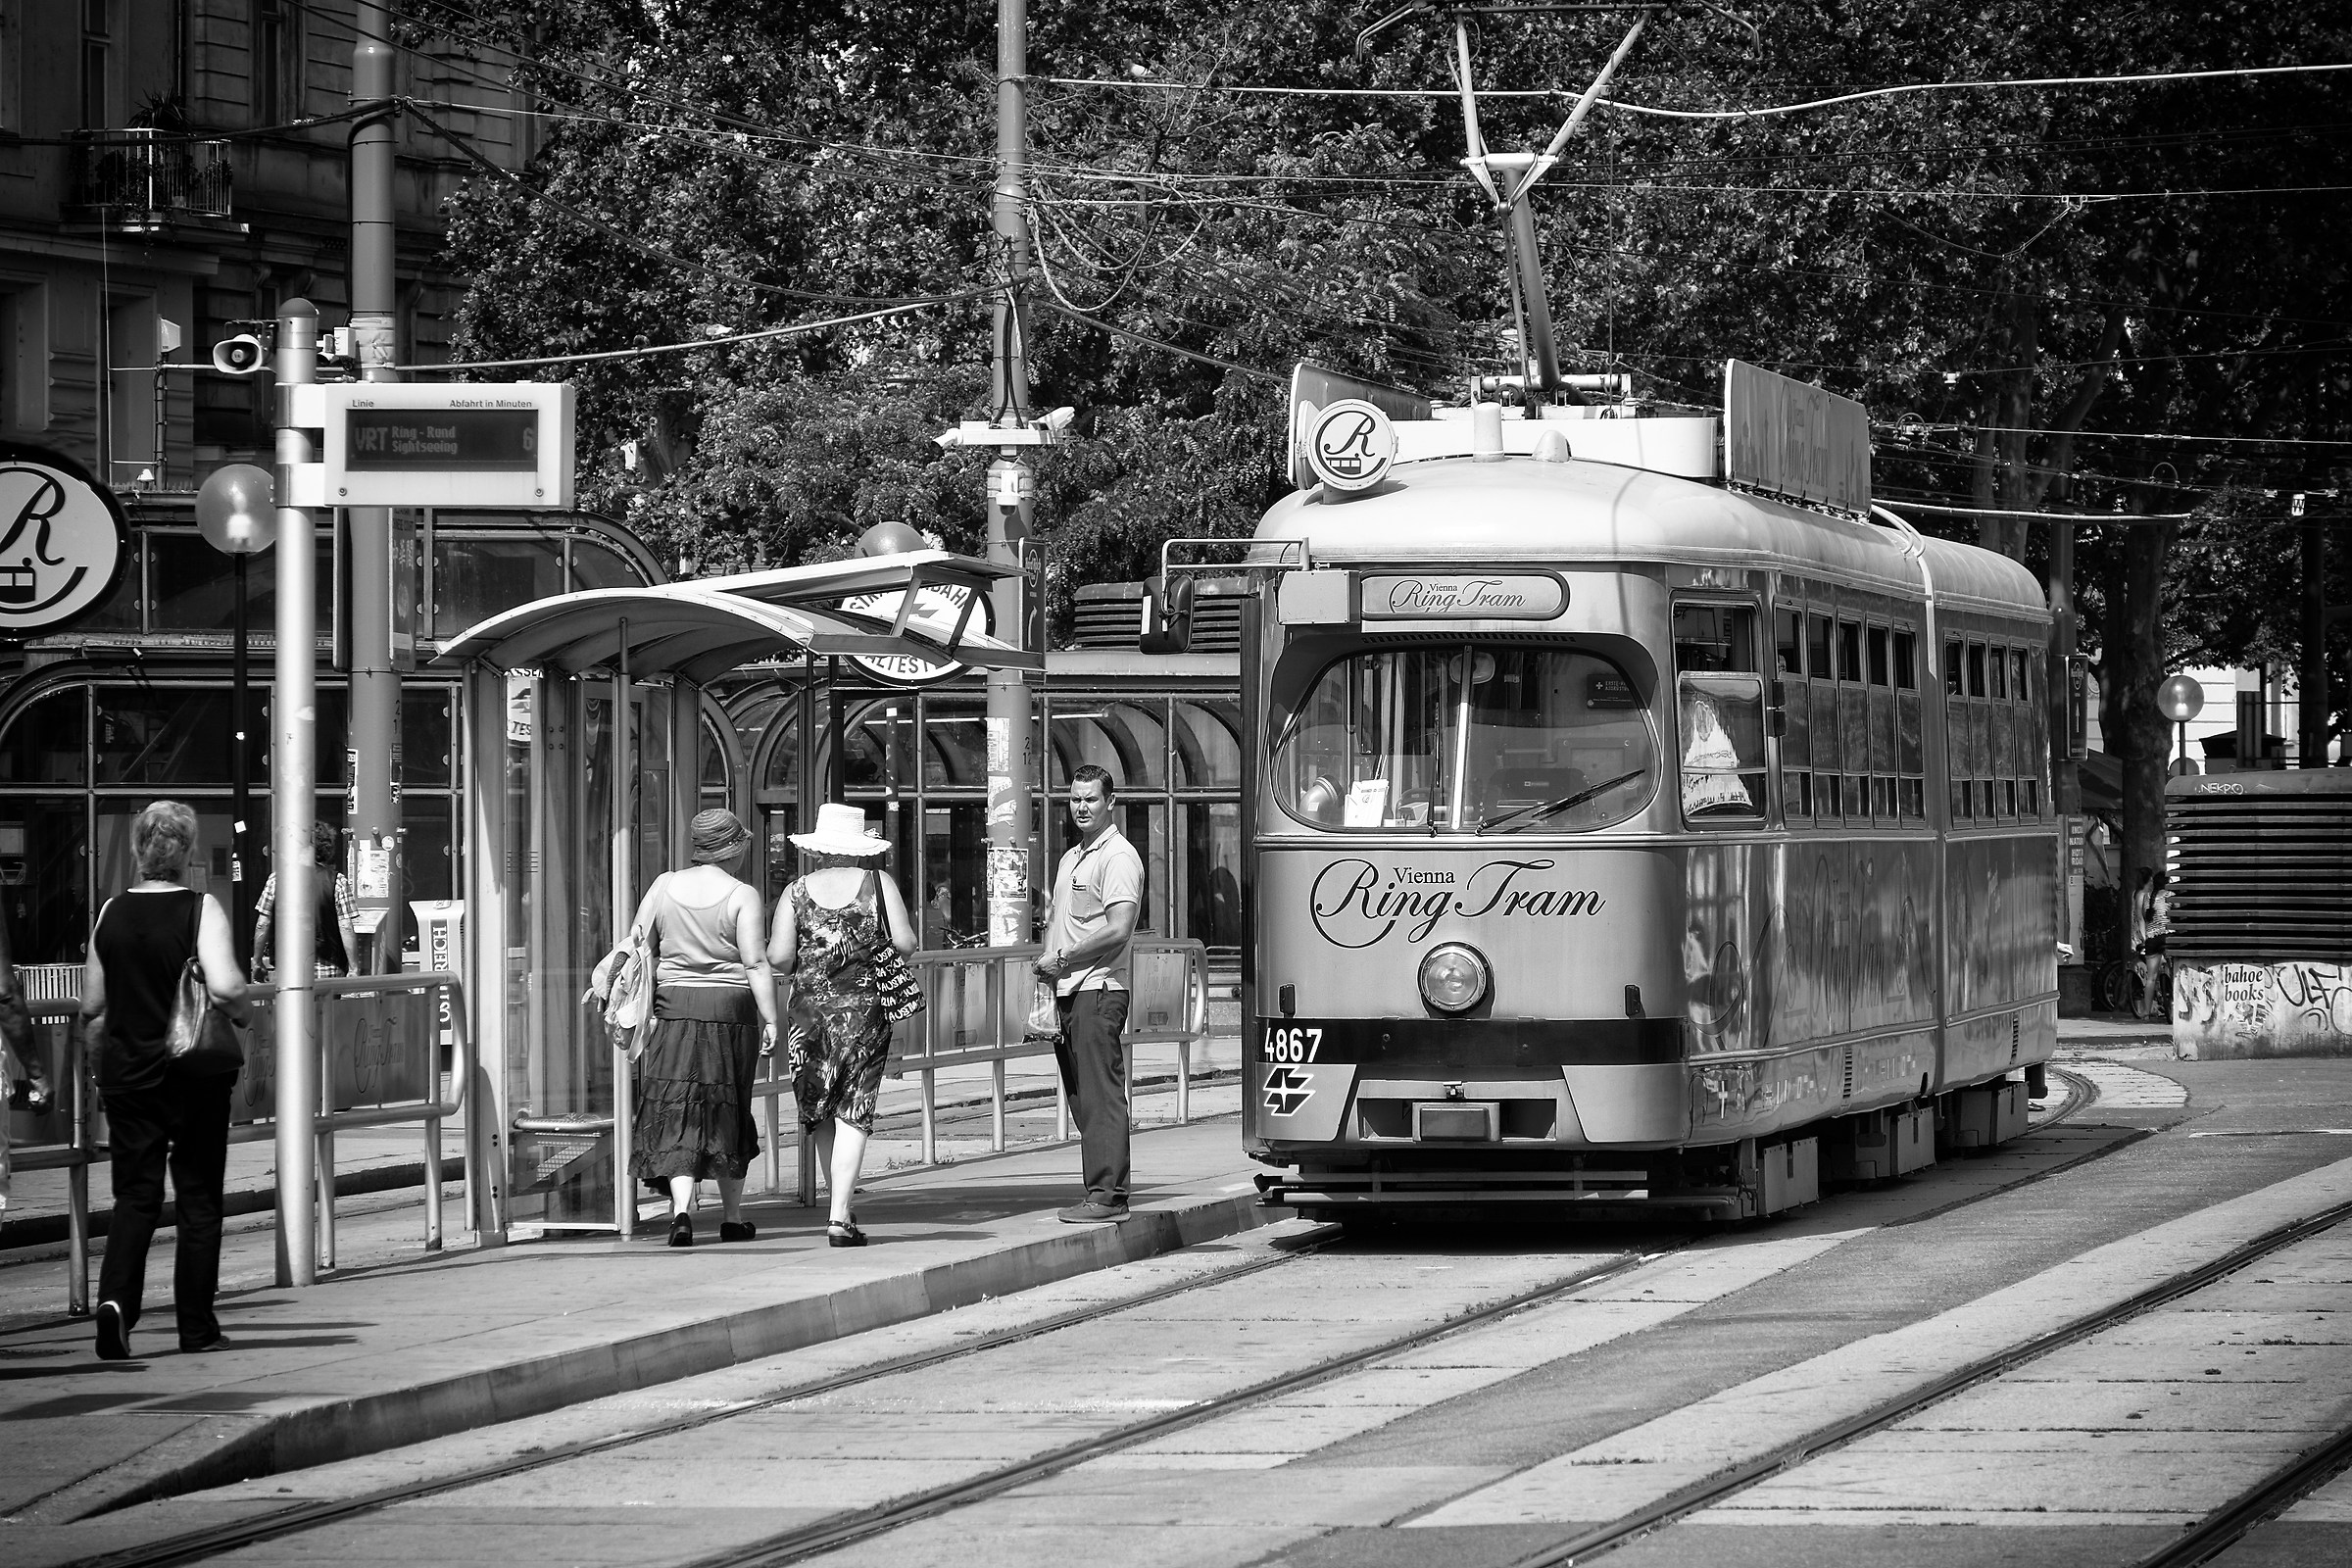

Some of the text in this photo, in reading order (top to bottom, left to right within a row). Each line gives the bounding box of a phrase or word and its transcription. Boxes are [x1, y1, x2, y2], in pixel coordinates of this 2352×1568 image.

[352, 399, 374, 408] Linie
[449, 399, 533, 408] Abfahrt in Minuten
[355, 426, 388, 451] VRT
[392, 425, 417, 440] Ring
[426, 425, 456, 439] Rund
[522, 426, 534, 451] 6
[392, 440, 458, 455] Sightseeing
[1389, 579, 1527, 612] Ring Tram
[1429, 583, 1458, 592] Vienna
[1393, 866, 1456, 884] Vienna
[1309, 858, 1607, 950] Ring Tram
[2224, 965, 2263, 984] bahoe
[2225, 984, 2264, 1002] books
[1264, 1027, 1323, 1063] 4867
